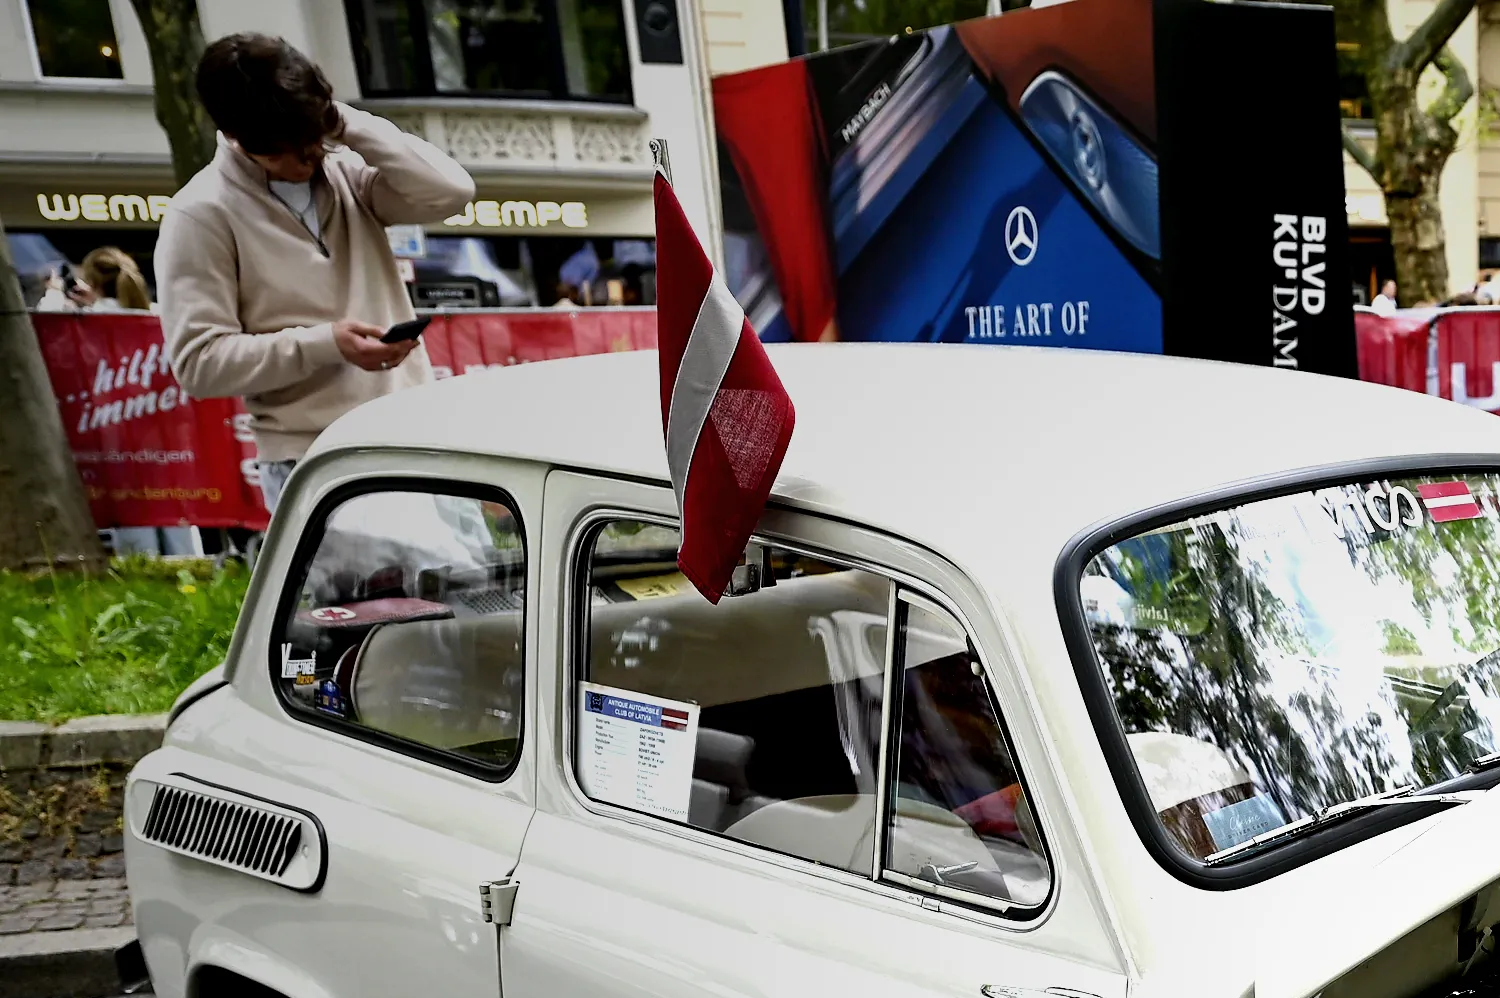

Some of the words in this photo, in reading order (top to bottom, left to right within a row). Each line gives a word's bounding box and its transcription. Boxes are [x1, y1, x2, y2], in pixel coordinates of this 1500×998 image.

[841, 82, 892, 143] MAYBACH
[36, 193, 172, 222] WEMP
[1301, 215, 1327, 316] BLVD
[1272, 213, 1299, 369] KU'DAM
[964, 305, 1007, 338] THE
[1012, 302, 1054, 337] ART
[1061, 300, 1090, 336] OF
[608, 699, 629, 709] ANTIQUE
[629, 703, 660, 716] AUTOMOBILE
[614, 708, 628, 717] CLUB
[627, 711, 635, 719] OF
[635, 713, 652, 722] LATVIA
